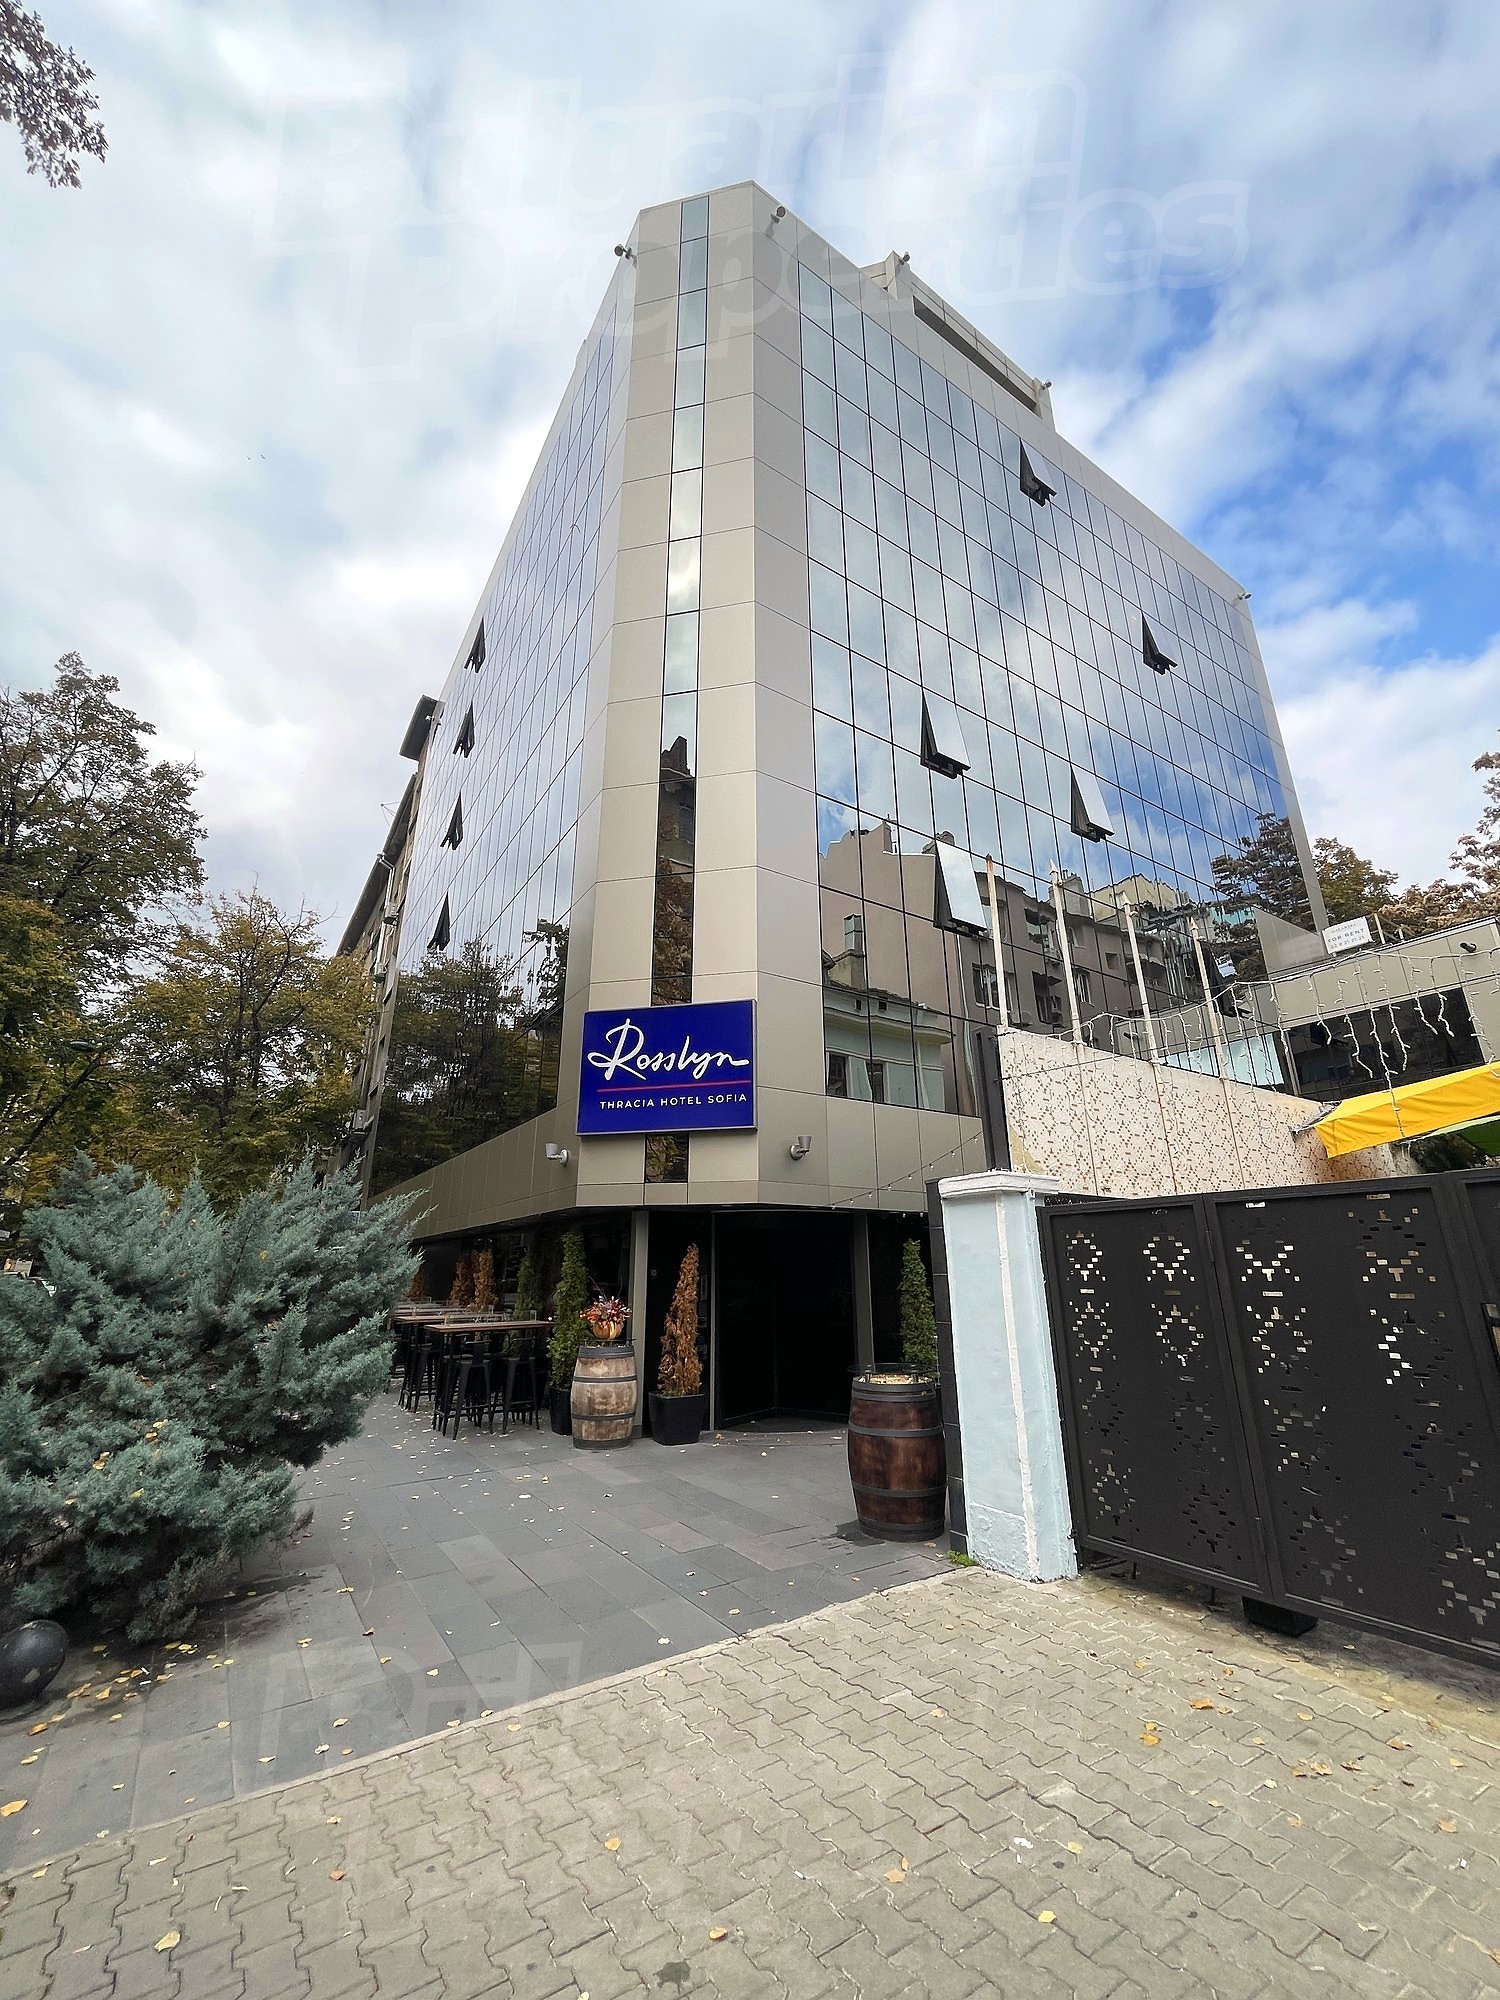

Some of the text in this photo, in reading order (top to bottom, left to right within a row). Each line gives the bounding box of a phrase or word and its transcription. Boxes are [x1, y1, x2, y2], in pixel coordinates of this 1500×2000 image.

[587, 1018, 750, 1081] Rosslyn
[600, 1093, 747, 1110] THRACIA HOTEL SOFIA
